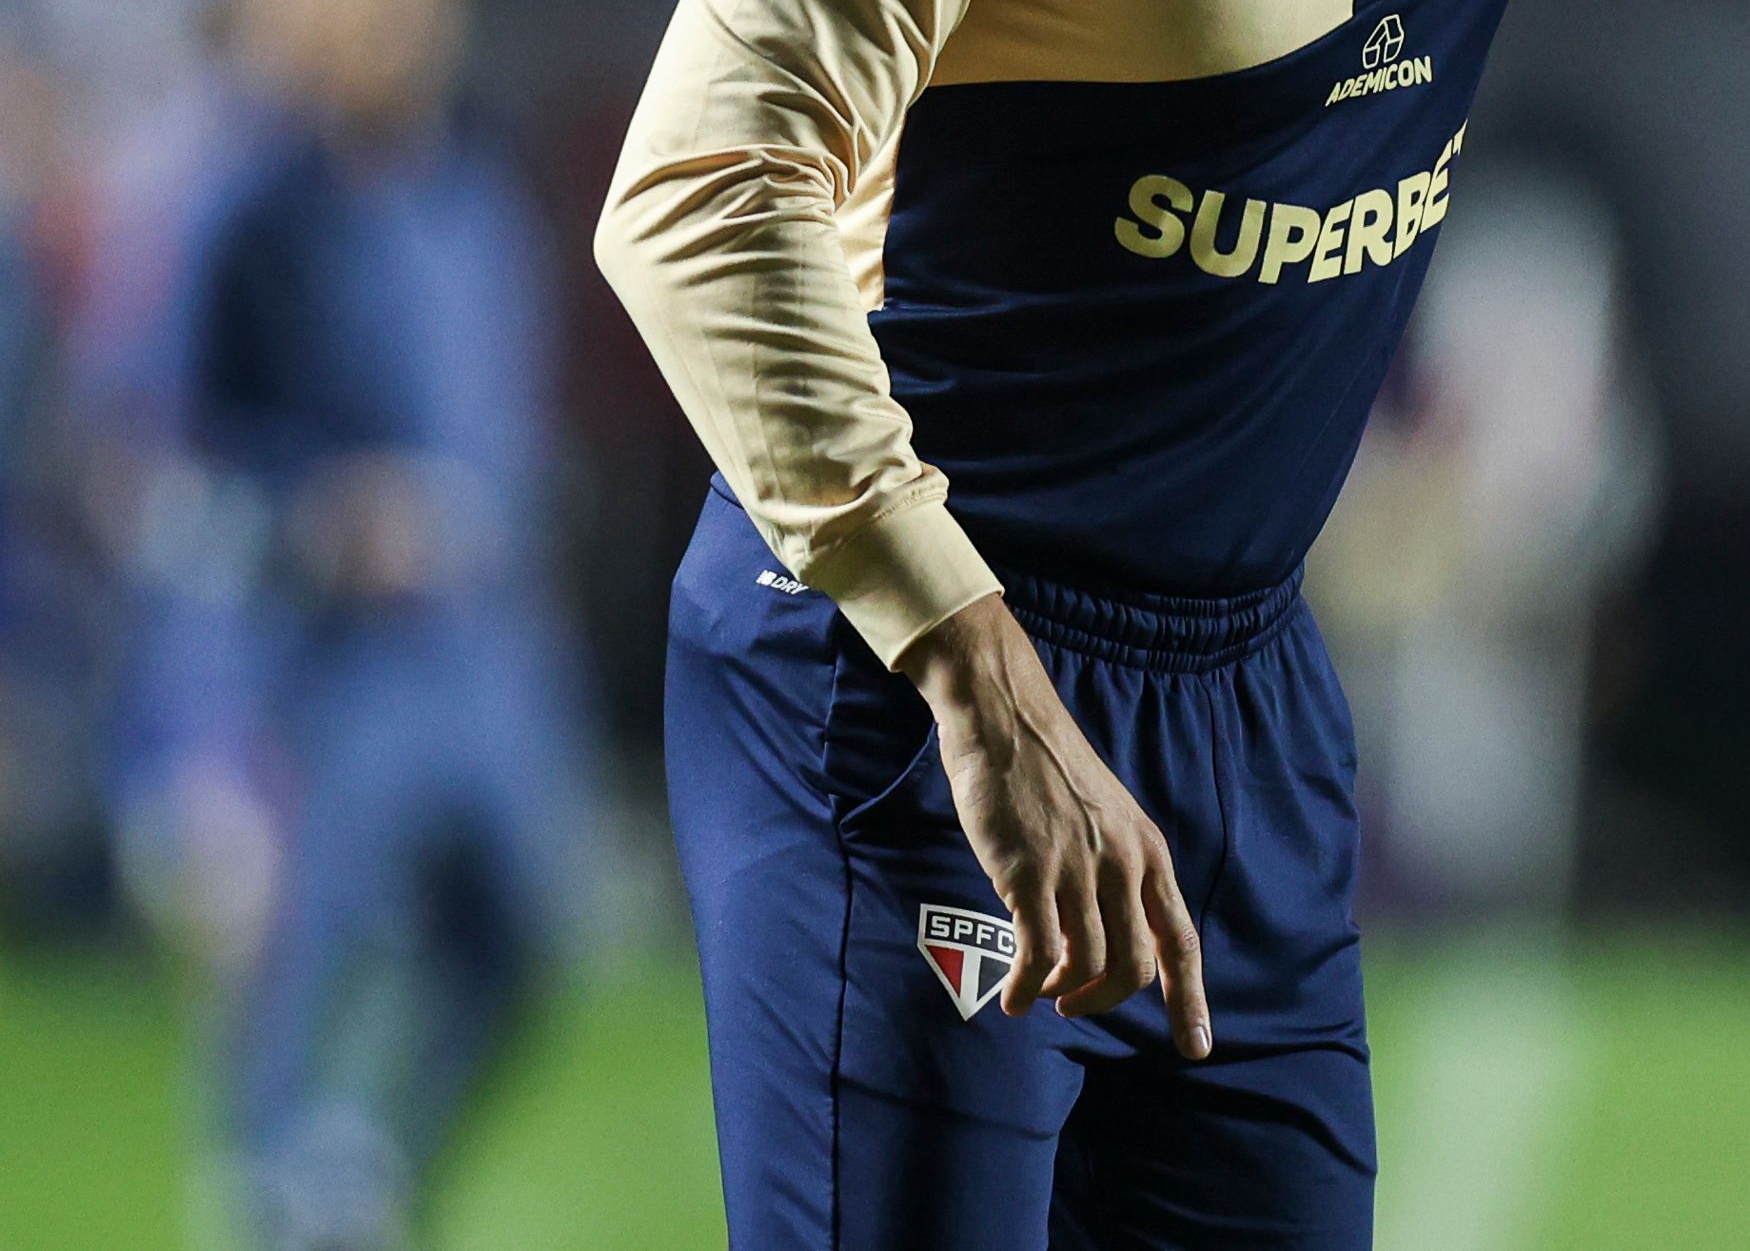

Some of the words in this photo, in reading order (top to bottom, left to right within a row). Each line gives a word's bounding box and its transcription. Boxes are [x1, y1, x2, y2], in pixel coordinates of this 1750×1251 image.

[1325, 55, 1433, 107] ADEMICON
[770, 575, 810, 596] DRY
[930, 915, 1015, 954] SPFC
